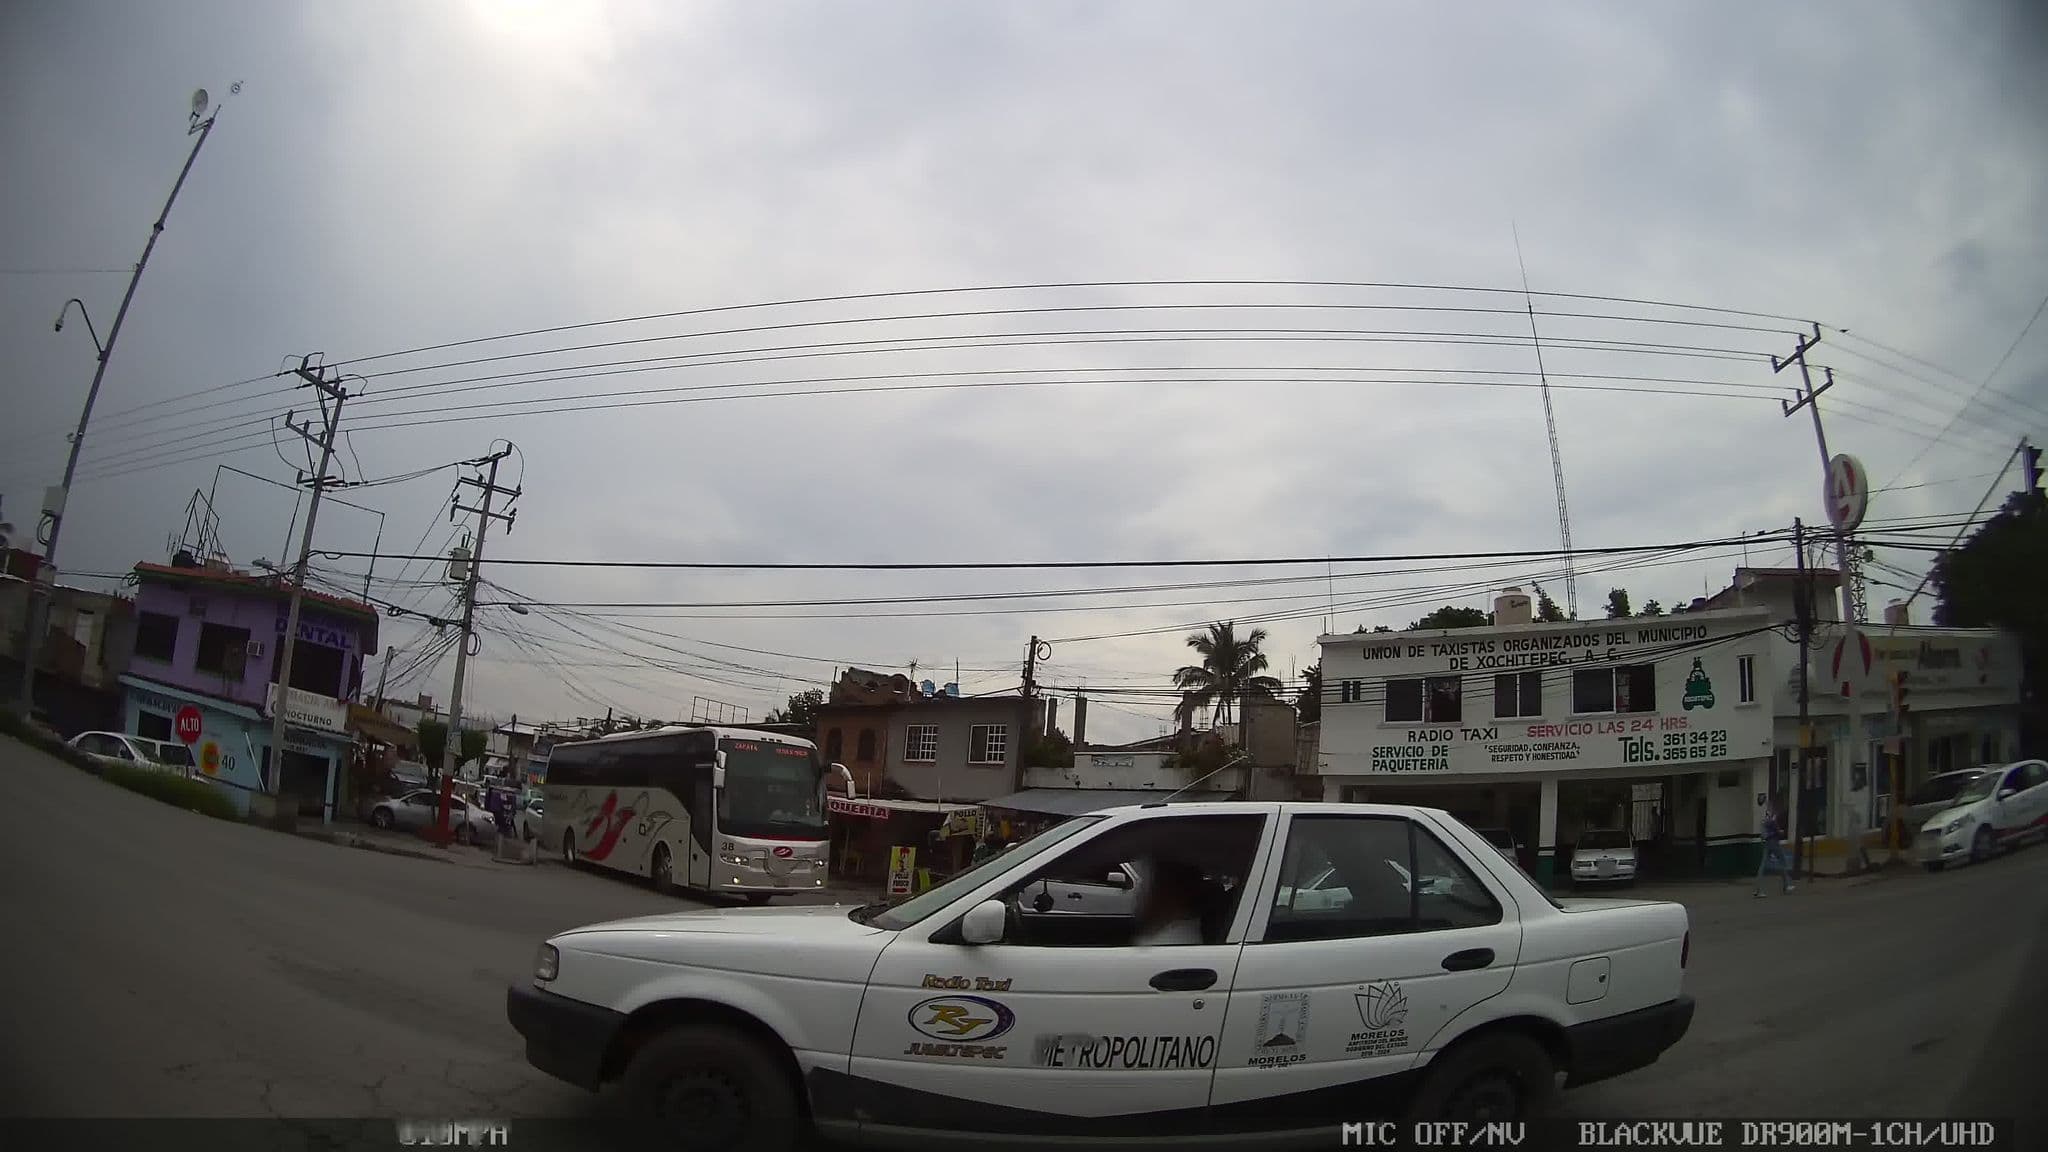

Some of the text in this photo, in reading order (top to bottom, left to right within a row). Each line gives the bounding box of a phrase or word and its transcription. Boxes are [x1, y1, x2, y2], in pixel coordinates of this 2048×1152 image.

[275, 615, 352, 649] DNTAL
[1408, 645, 1425, 658] DE
[1431, 640, 1495, 656] TAXISTAS
[1504, 634, 1600, 653] ORGANIZADOS
[1606, 631, 1630, 646] DEL
[1450, 657, 1468, 671] DE
[180, 717, 200, 732] ALTO
[1526, 716, 1692, 739] SERVICIO LAS 24 HRS.
[1408, 727, 1498, 743] RADIO TAXI
[1663, 729, 1727, 746] 361 34 23
[1372, 745, 1449, 759] SERVICIO DE
[1618, 735, 1660, 764] Tels.
[1663, 747, 1686, 761] 365
[1711, 744, 1727, 758] 25
[1372, 758, 1449, 773] PAQUETERIA
[1491, 753, 1524, 763] RESPETO
[1525, 753, 1531, 762] Y
[720, 841, 735, 852] 38
[1350, 1029, 1405, 1041] MORELOS
[1038, 1036, 1215, 1069] EROPOLITANO
[1248, 1053, 1307, 1066] MORELOS
